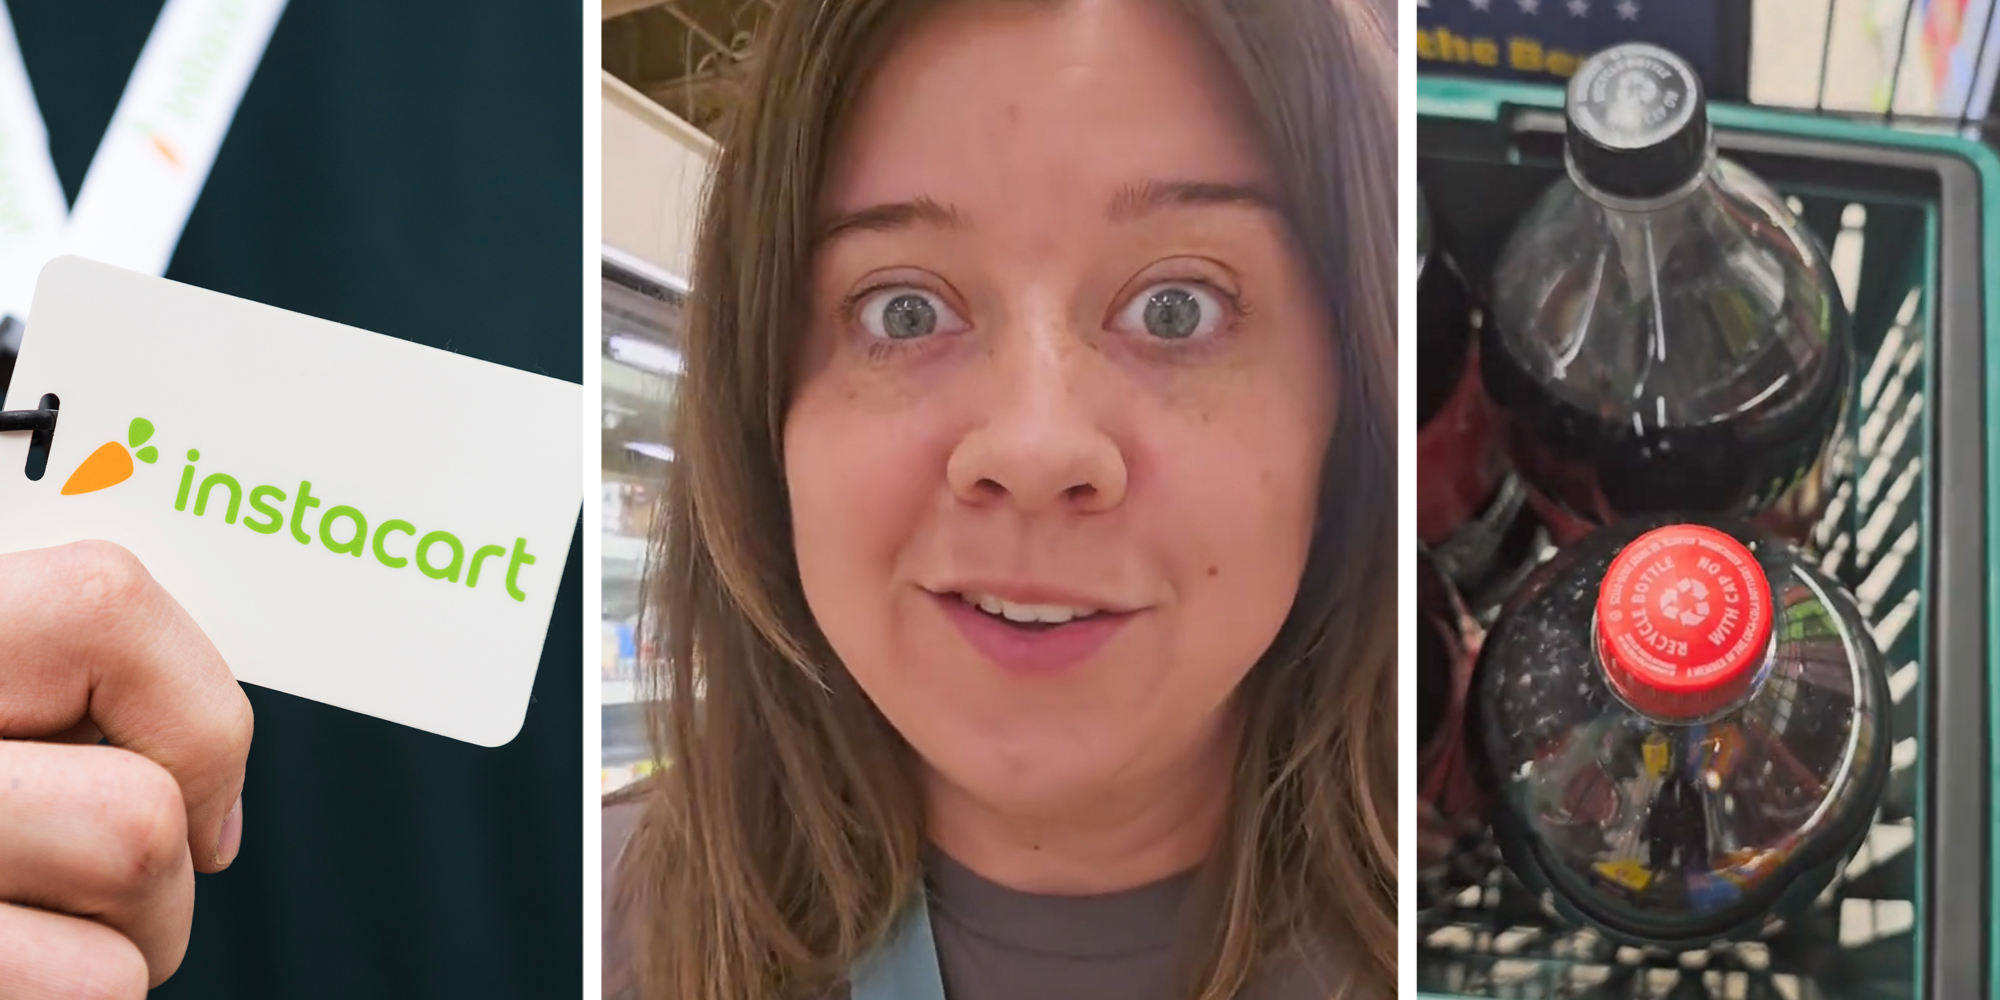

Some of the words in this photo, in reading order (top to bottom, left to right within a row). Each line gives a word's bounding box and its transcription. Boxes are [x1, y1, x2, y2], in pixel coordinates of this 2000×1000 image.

[174, 448, 536, 602] instacart
[1631, 556, 1676, 604] BOTTLE
[1697, 556, 1721, 575] ON
[1717, 575, 1740, 604] CAP
[1631, 607, 1689, 657] RECYCLE
[1707, 606, 1740, 647] WITH
